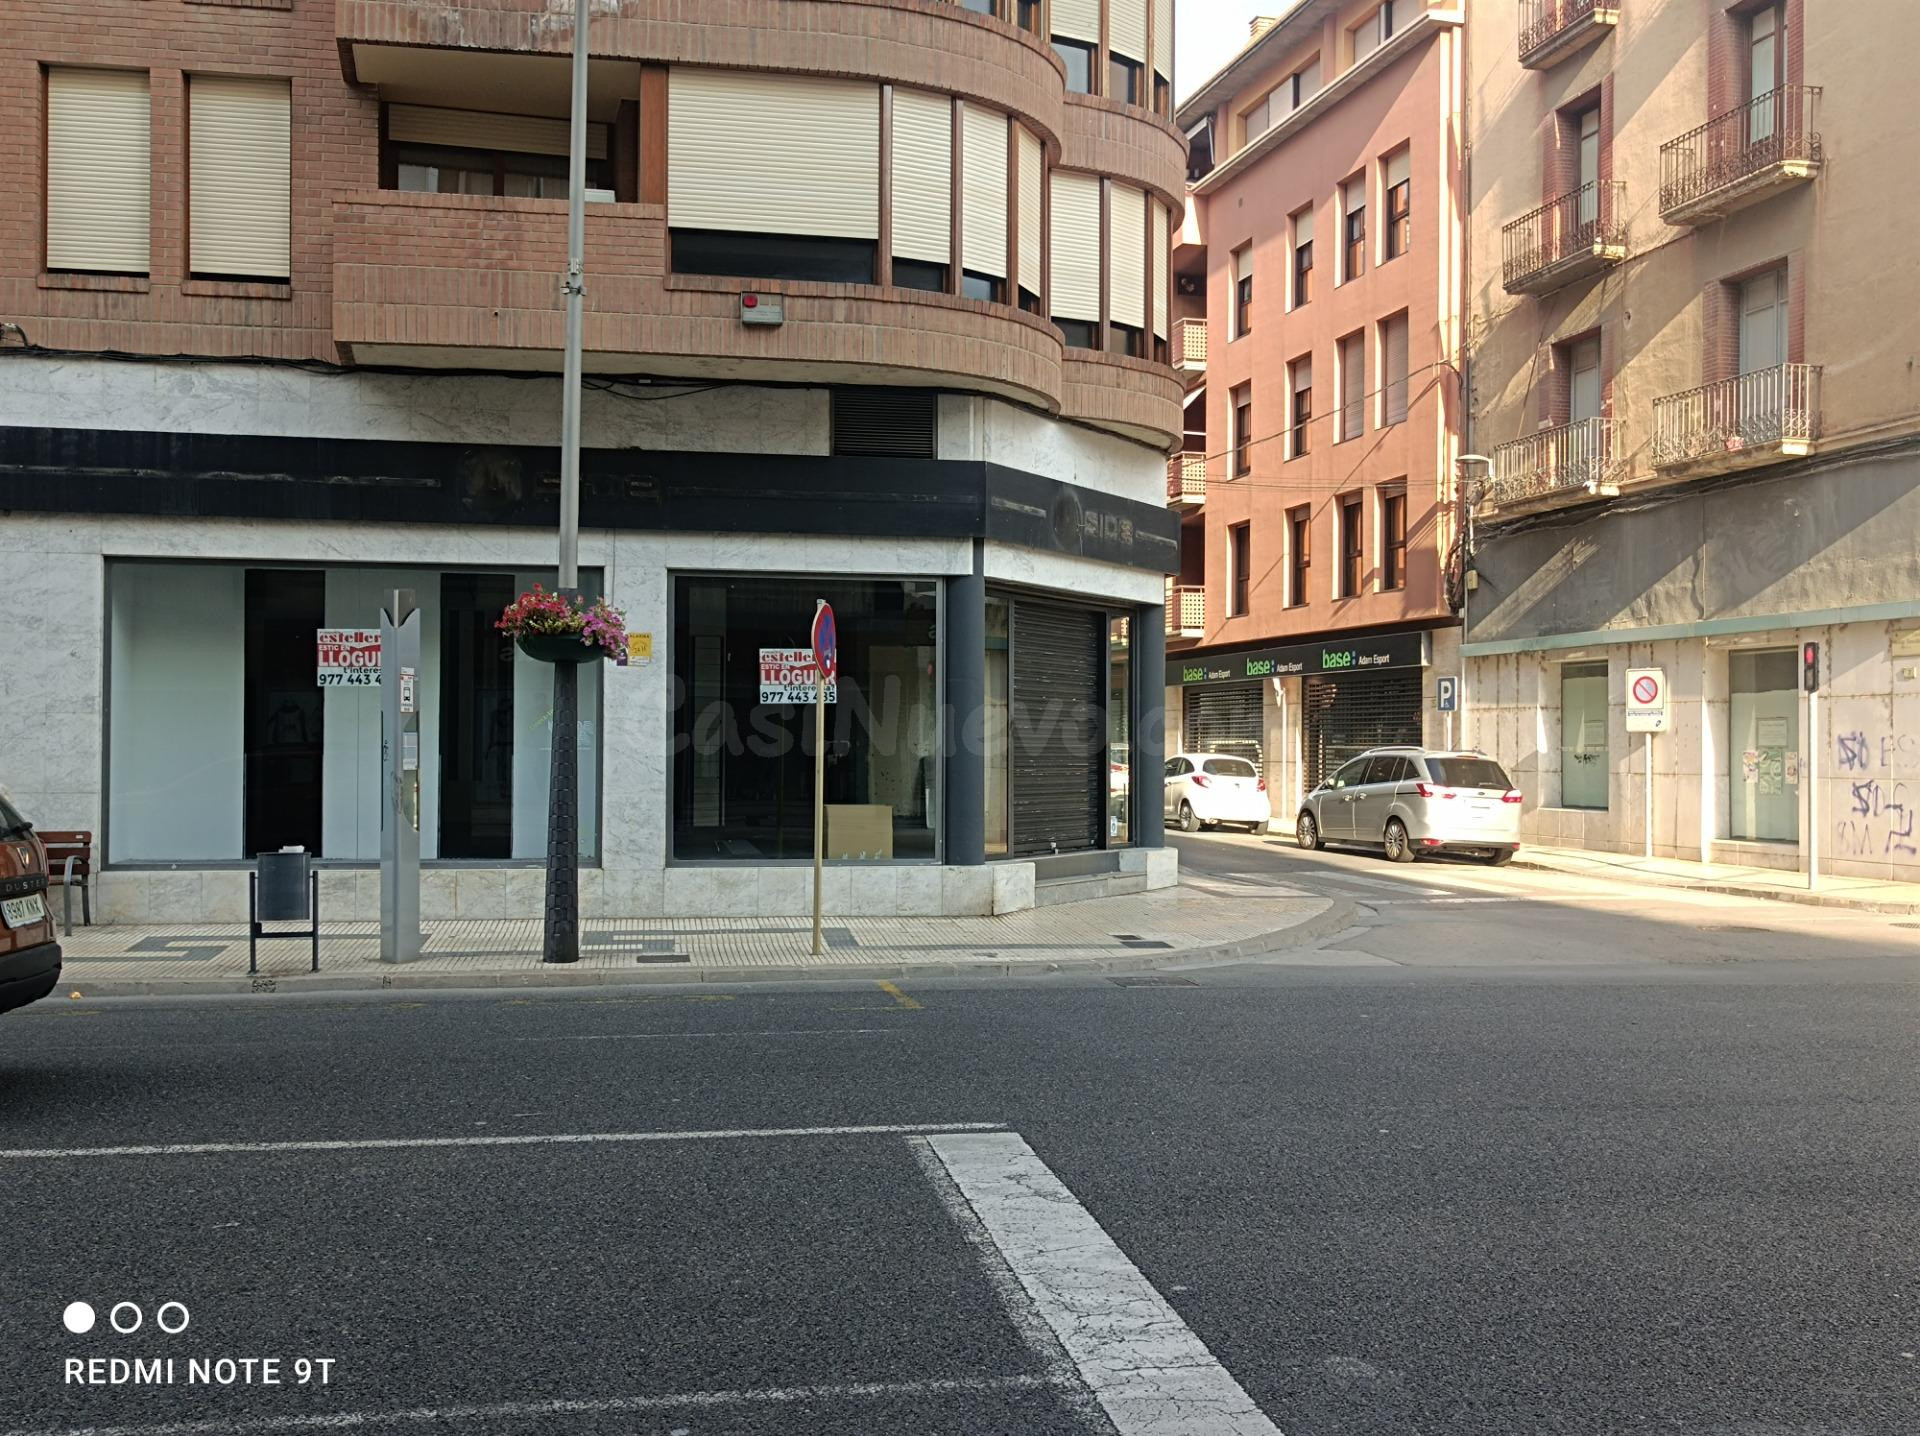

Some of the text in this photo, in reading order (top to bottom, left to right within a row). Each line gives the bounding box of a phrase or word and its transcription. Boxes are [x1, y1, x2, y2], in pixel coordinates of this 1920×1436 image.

[1358, 655, 1373, 665] Adam
[1373, 653, 1390, 666] Esport
[319, 674, 343, 685] 977
[347, 674, 371, 685] 443
[761, 669, 836, 685] LLOGUR
[762, 692, 784, 702] 977
[787, 692, 809, 702] 443
[1440, 681, 1452, 708] P
